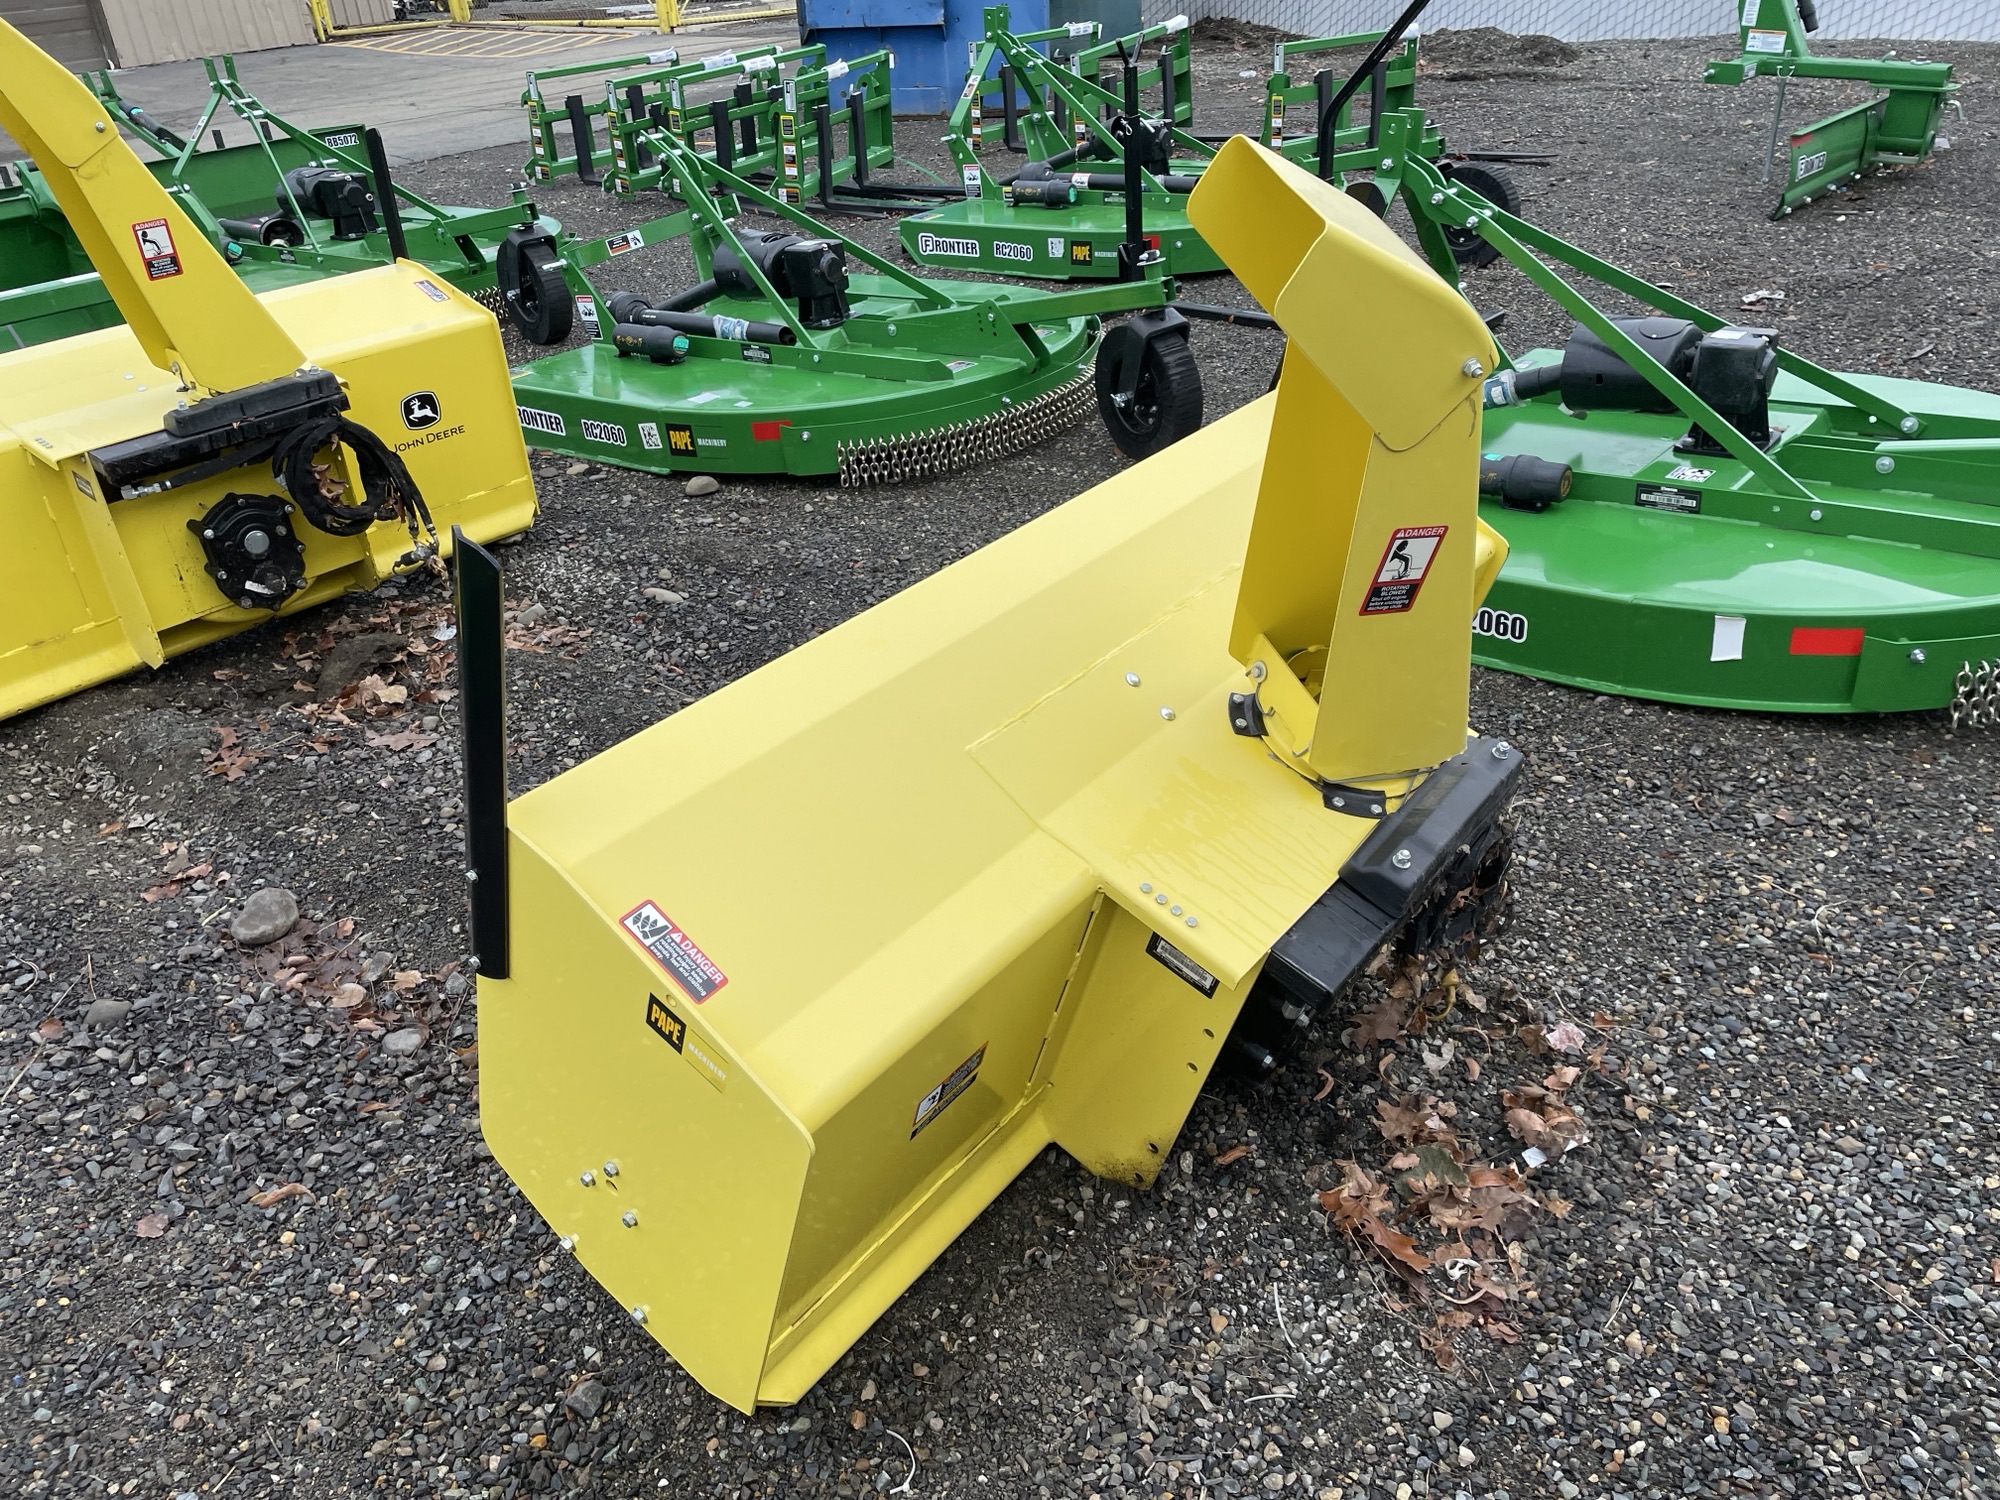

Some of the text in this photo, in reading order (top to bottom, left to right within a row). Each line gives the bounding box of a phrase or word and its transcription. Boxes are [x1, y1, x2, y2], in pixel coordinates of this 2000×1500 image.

[326, 134, 358, 148] BB5072
[139, 219, 166, 229] DANGER
[920, 235, 978, 255] FRONTIER
[995, 243, 1031, 259] RC2060
[517, 408, 563, 433] RONTIER
[582, 421, 626, 444] RC2060
[394, 425, 465, 453] JOHN DEERE
[697, 438, 726, 446] MACHINERY
[1404, 527, 1445, 537] DANGER
[1473, 609, 1526, 640] 060
[648, 945, 664, 960] away.
[658, 938, 703, 983] rotating auger, keep
[670, 941, 684, 955] avoid
[681, 954, 697, 969] injury
[695, 967, 708, 980] from
[679, 939, 724, 983] DANGER
[653, 941, 672, 958] hands,
[678, 965, 689, 976] and
[685, 975, 707, 996] clothing
[688, 1041, 726, 1080] MACHINERY
